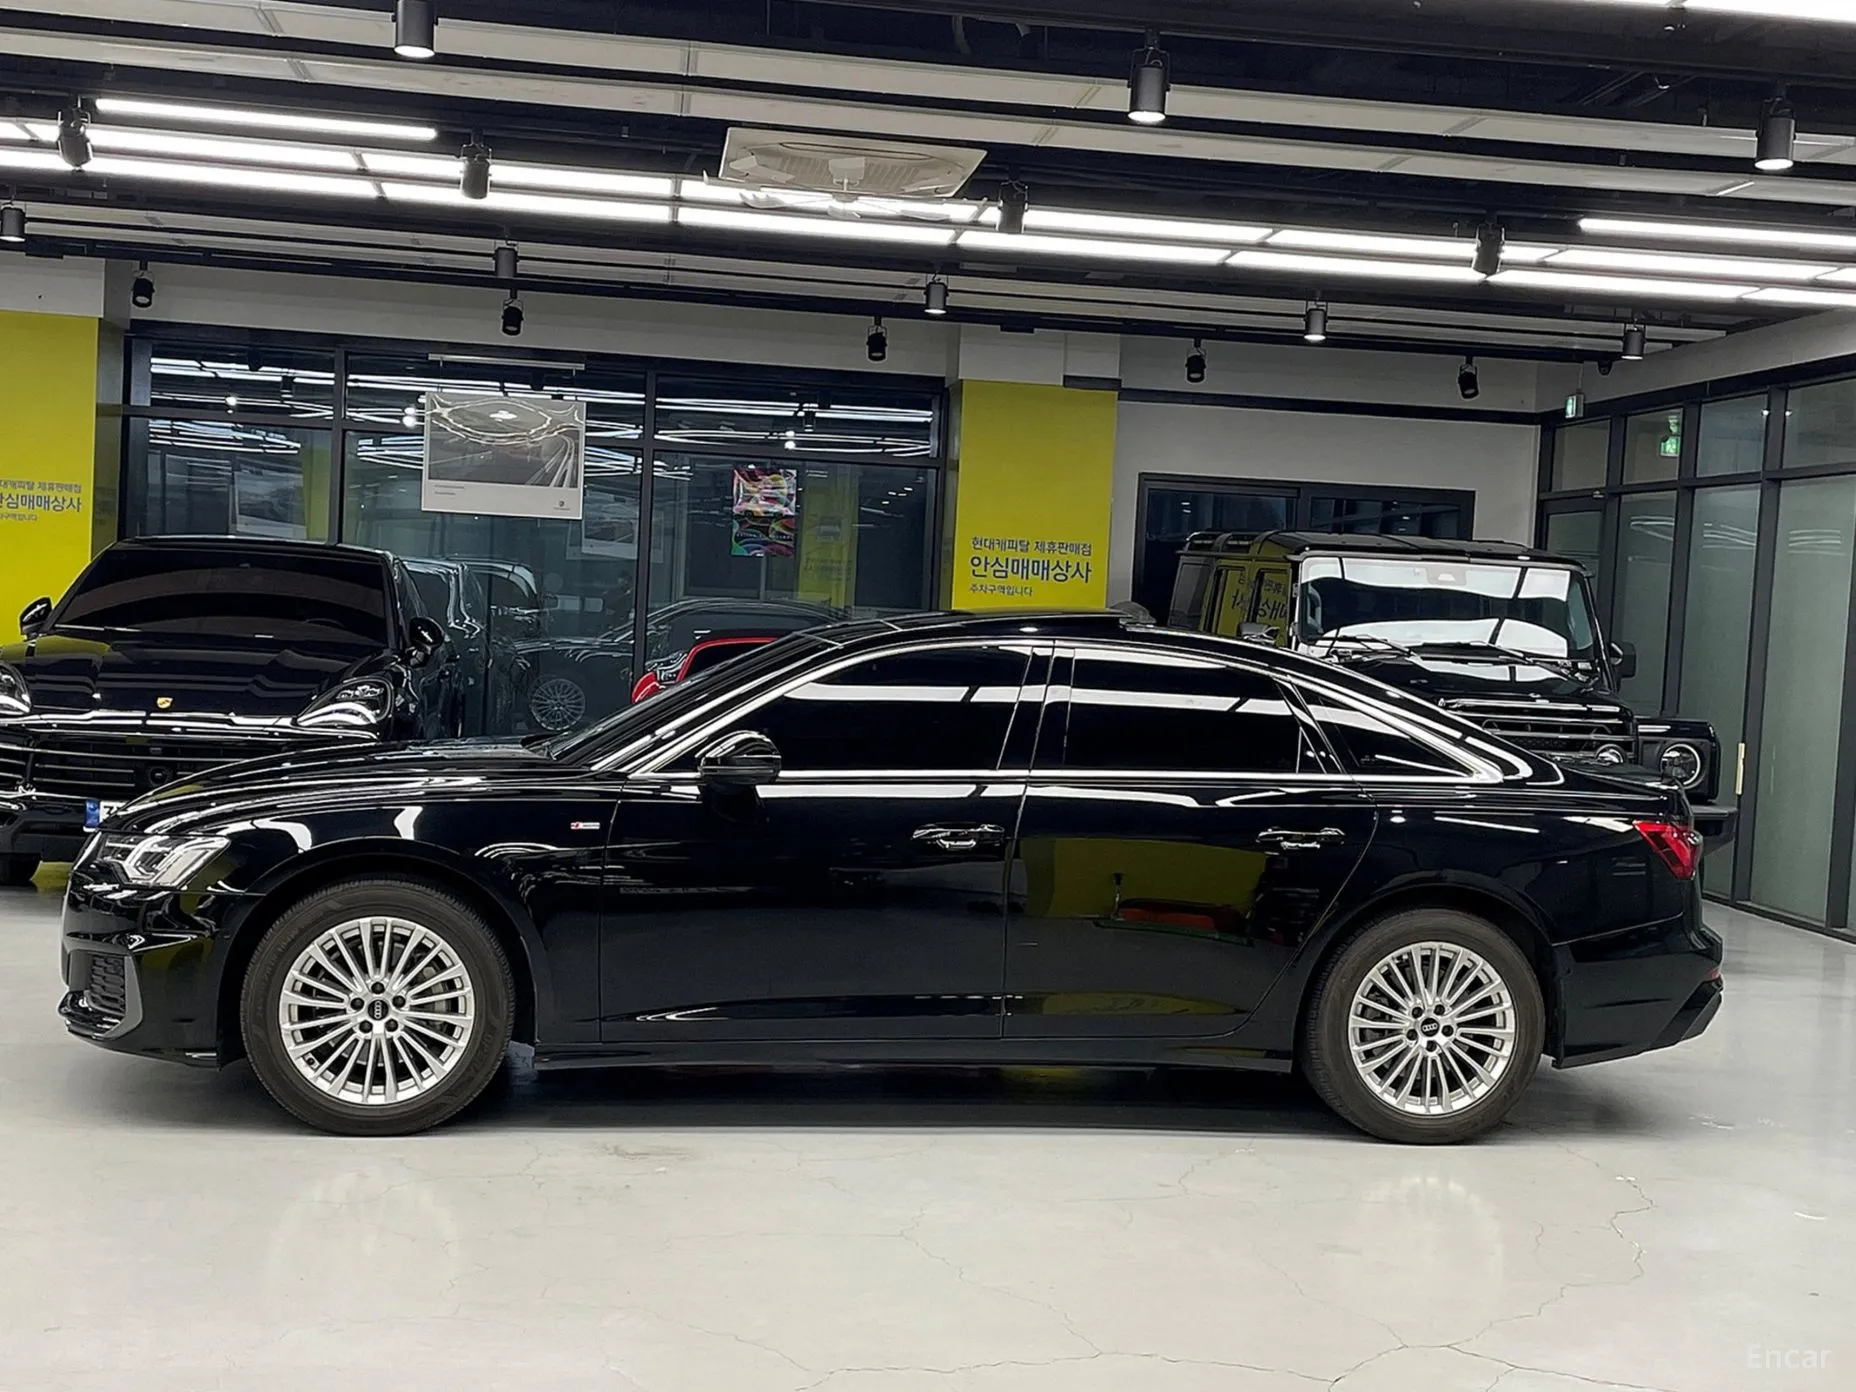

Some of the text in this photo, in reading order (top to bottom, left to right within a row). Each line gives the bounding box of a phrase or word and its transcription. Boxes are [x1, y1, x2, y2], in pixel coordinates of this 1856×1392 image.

[972, 537, 1092, 557] 현대캐피탈 제휴판매점
[971, 556, 1092, 583] 안심매매상사
[970, 584, 1033, 596] 주차구역입니다
